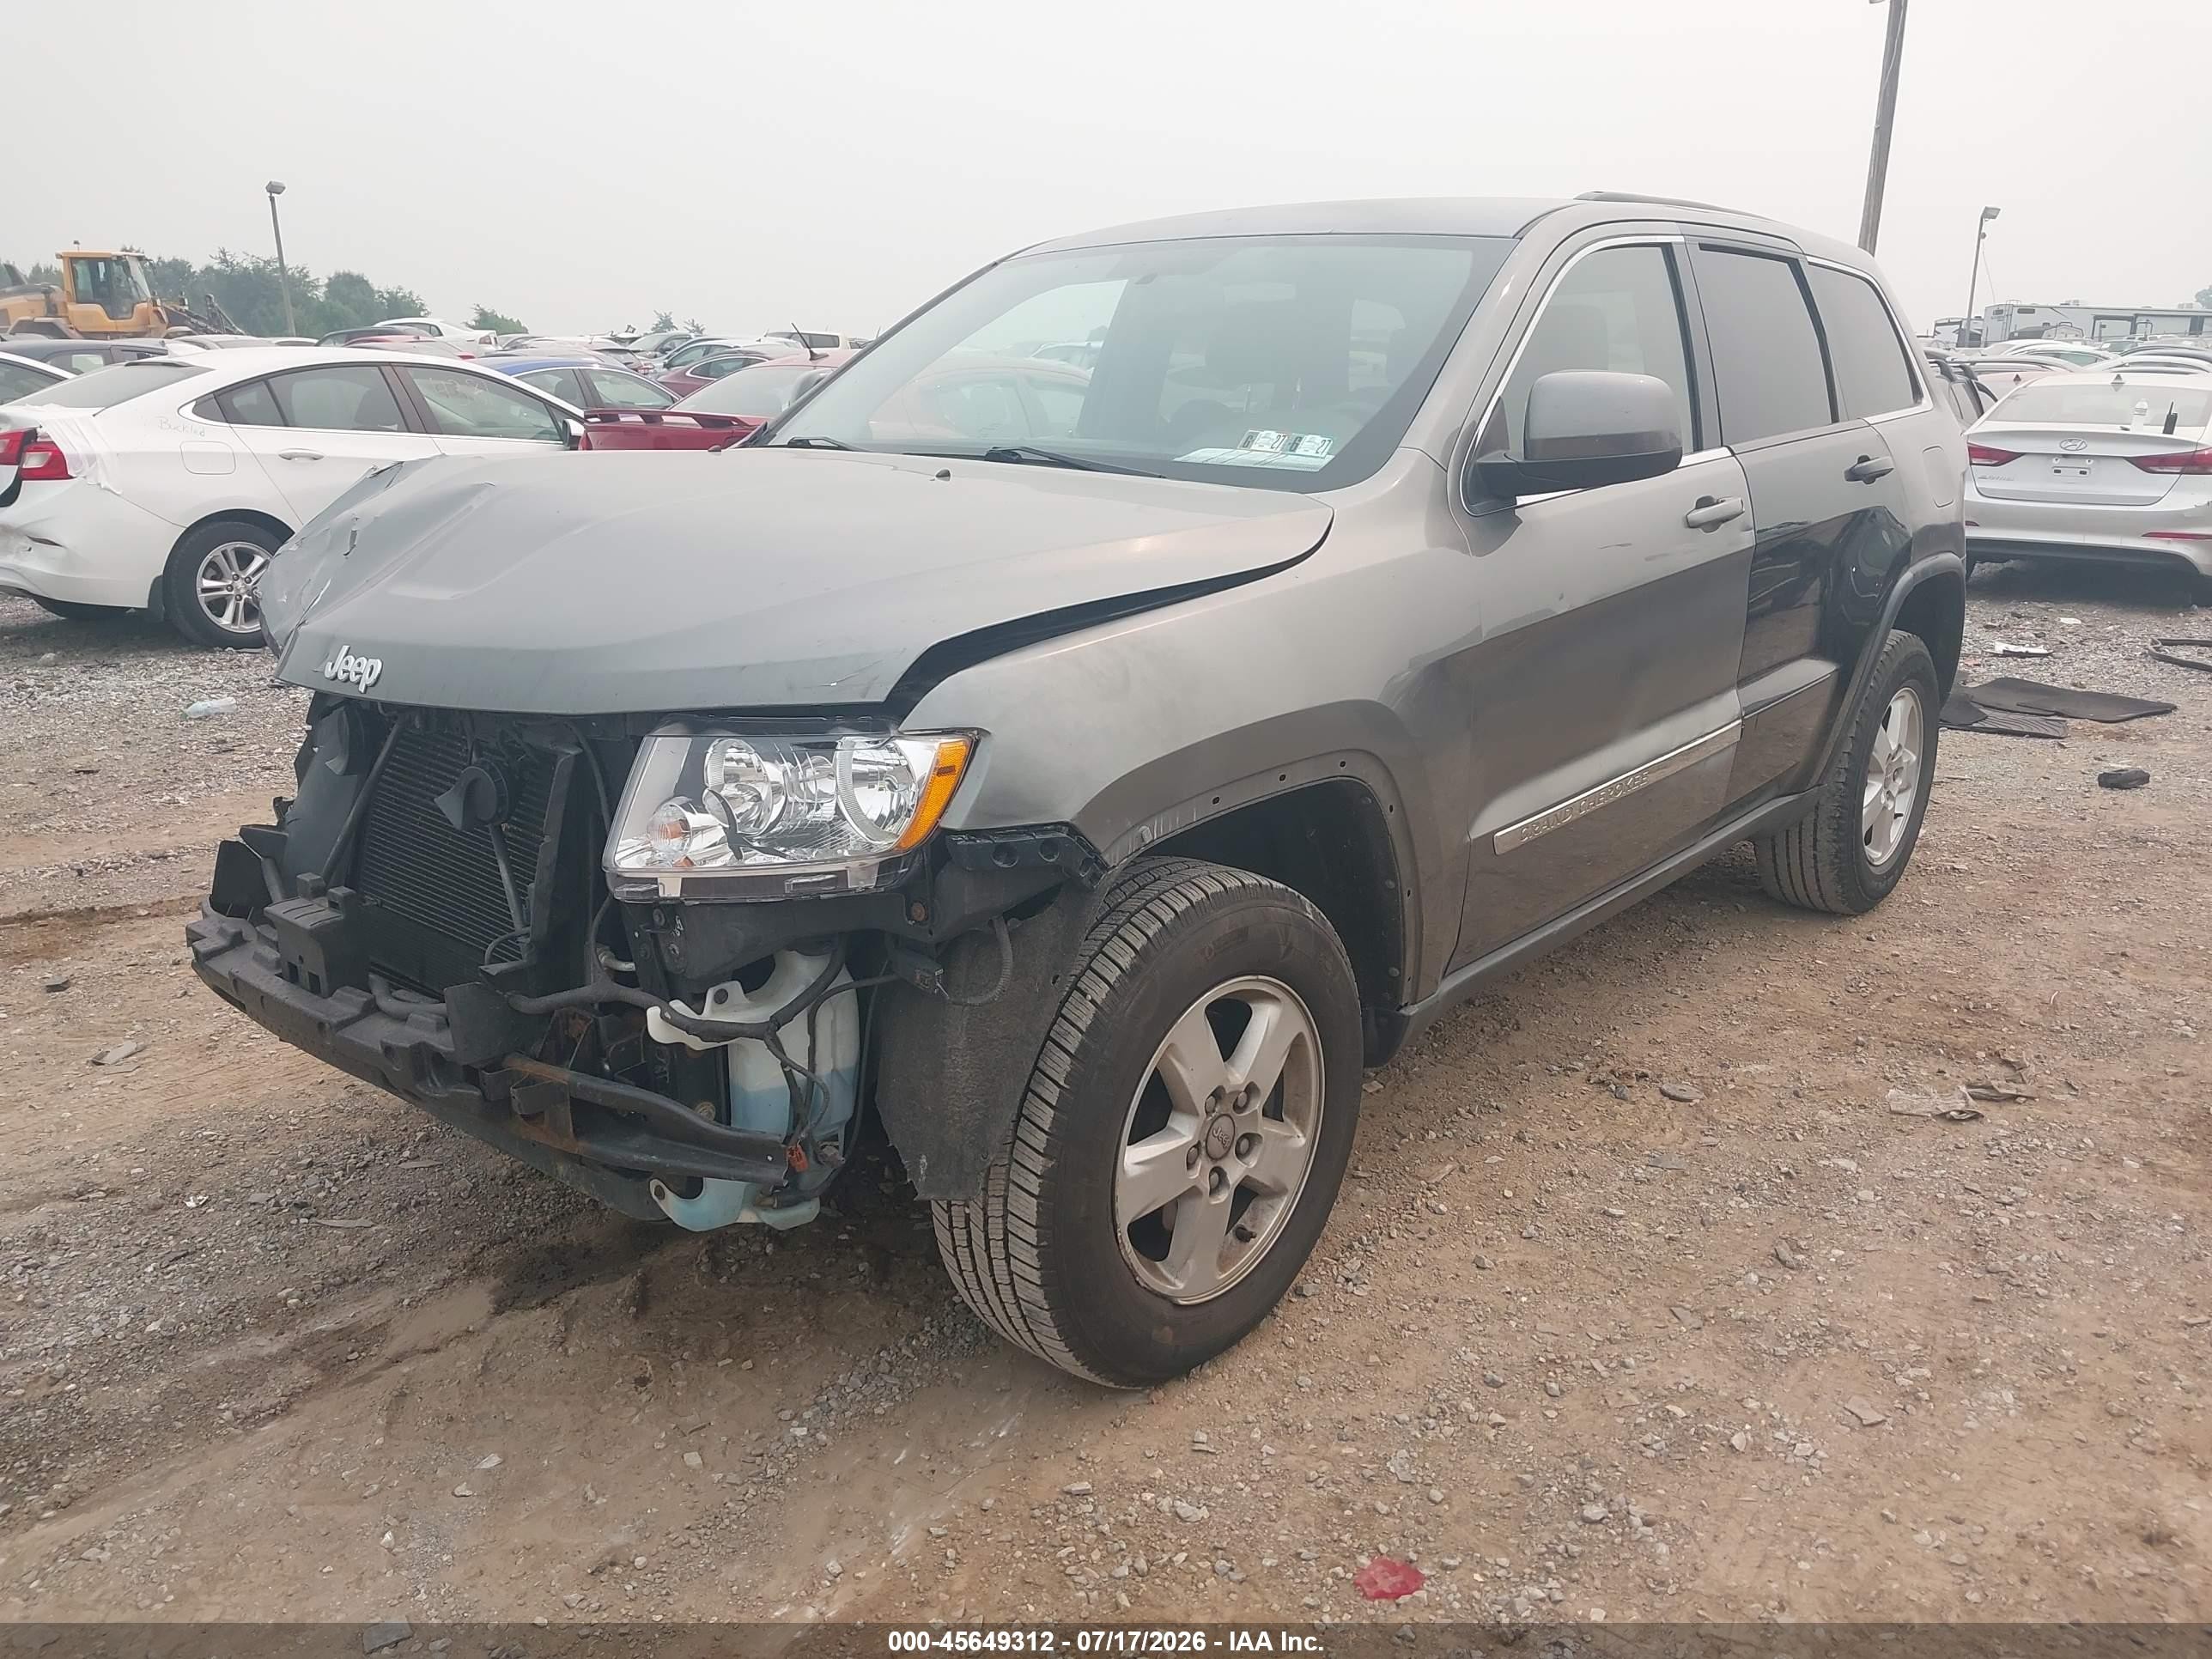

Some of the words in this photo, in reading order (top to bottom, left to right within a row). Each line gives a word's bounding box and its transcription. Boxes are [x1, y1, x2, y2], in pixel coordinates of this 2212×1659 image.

[1270, 434, 1286, 450] 27
[1316, 439, 1332, 455] 27
[325, 644, 382, 694] Jeep
[1519, 806, 1573, 842] GRAND
[1580, 770, 1650, 815] CHEROKEE
